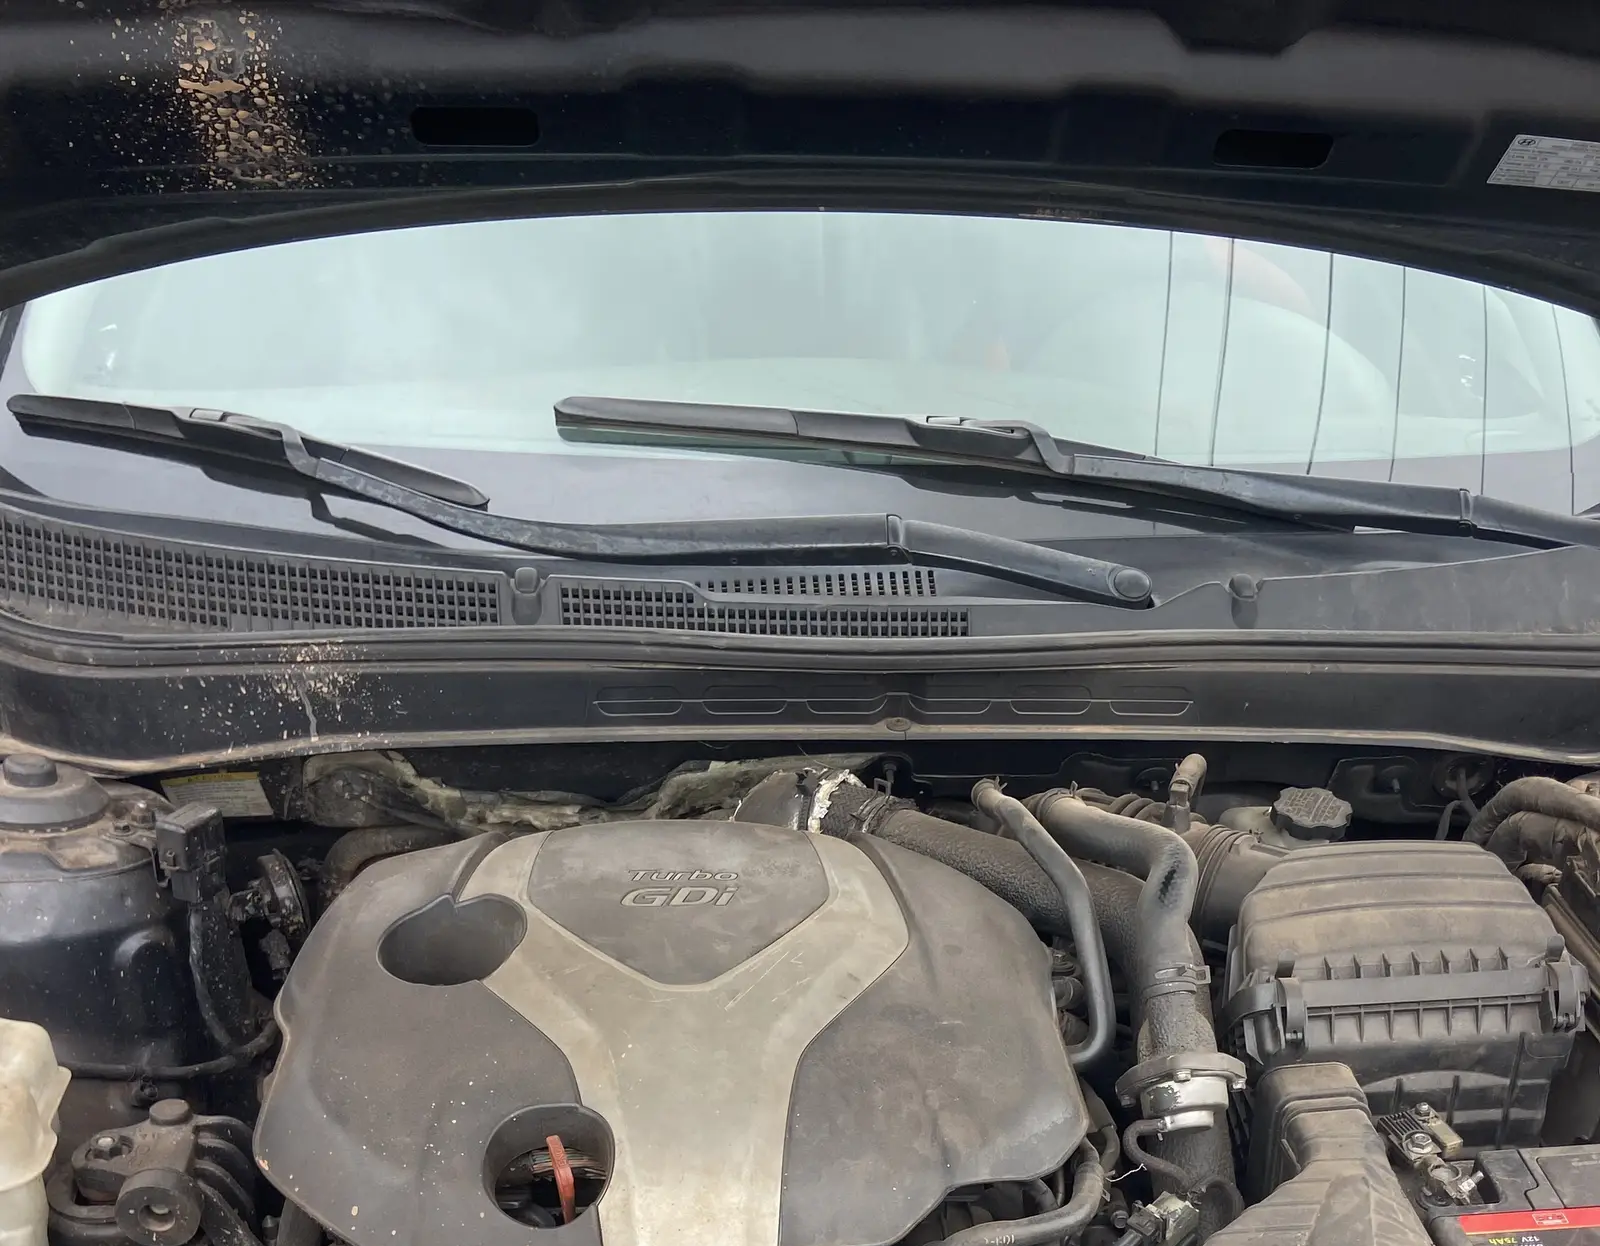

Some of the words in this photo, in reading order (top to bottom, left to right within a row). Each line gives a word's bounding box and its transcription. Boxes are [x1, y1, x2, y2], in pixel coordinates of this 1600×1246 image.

[628, 869, 739, 882] Turbo
[620, 886, 739, 908] GDi
[1488, 1237, 1518, 1245] 75Ah
